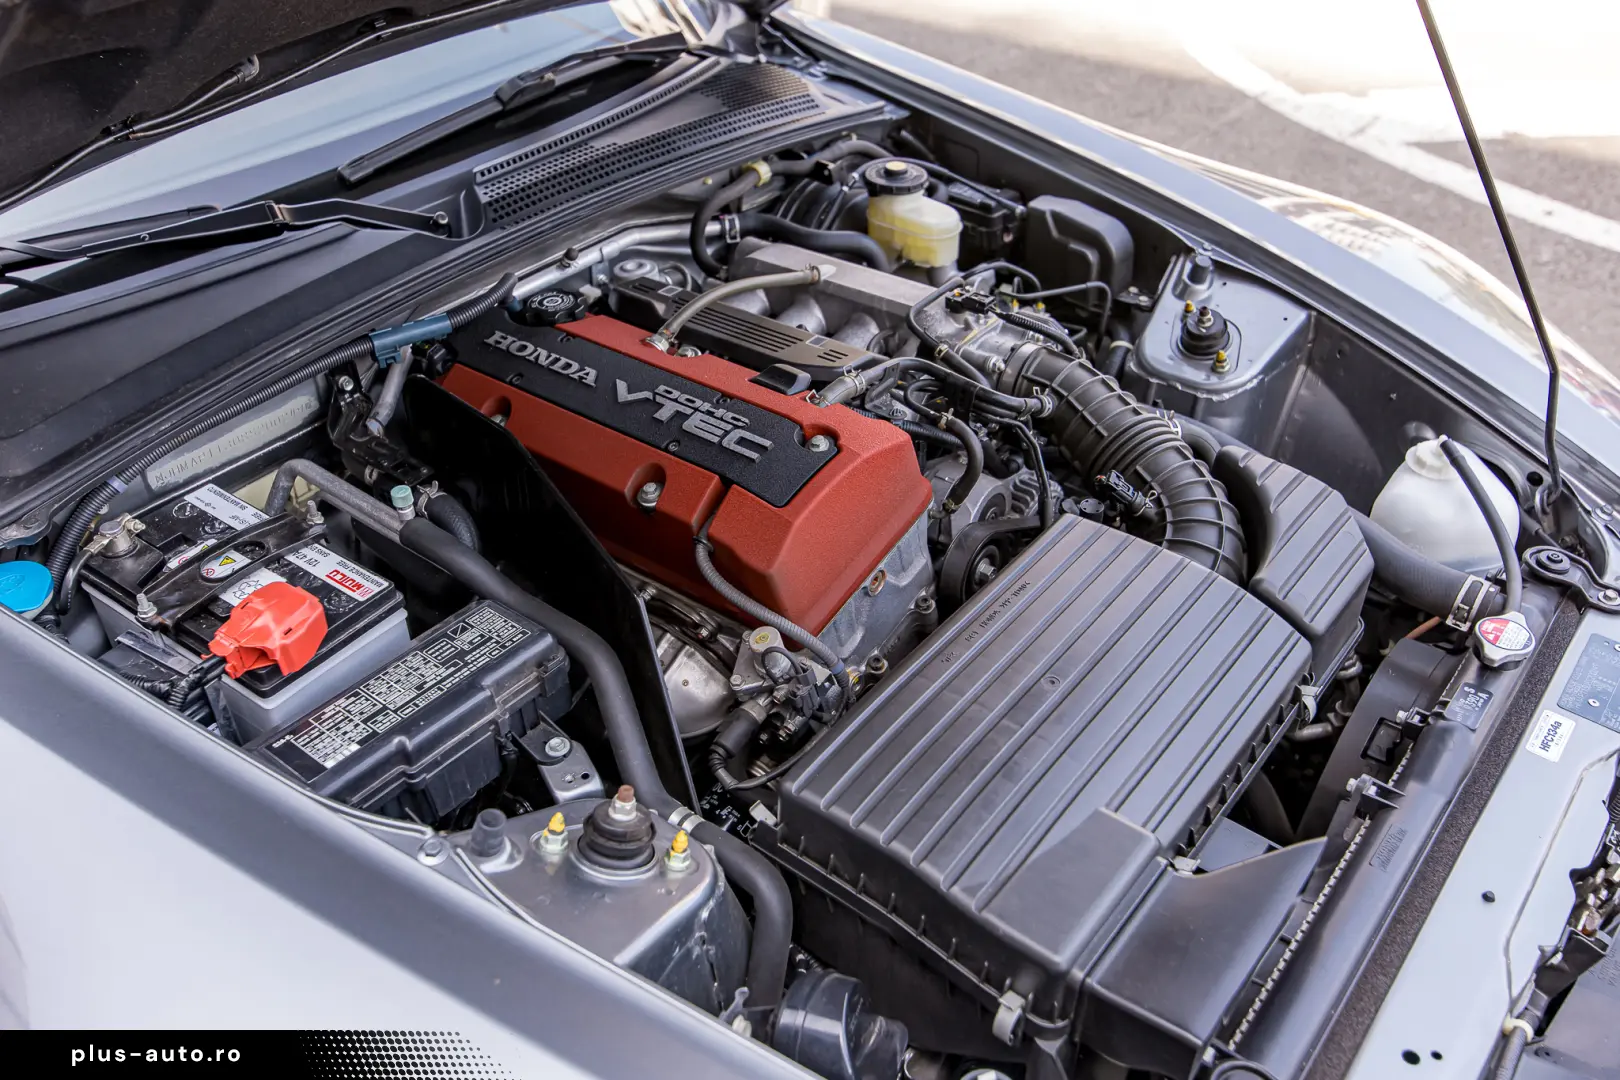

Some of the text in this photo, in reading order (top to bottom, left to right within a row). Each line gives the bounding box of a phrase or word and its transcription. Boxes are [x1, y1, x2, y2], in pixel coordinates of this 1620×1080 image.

[484, 330, 599, 388] HONDA
[654, 384, 750, 427] DOHC
[304, 557, 320, 567] 12V
[336, 559, 384, 588] MAINTENANCE FREE
[325, 569, 365, 593] MUTLU
[1539, 720, 1563, 752] HFC134a
